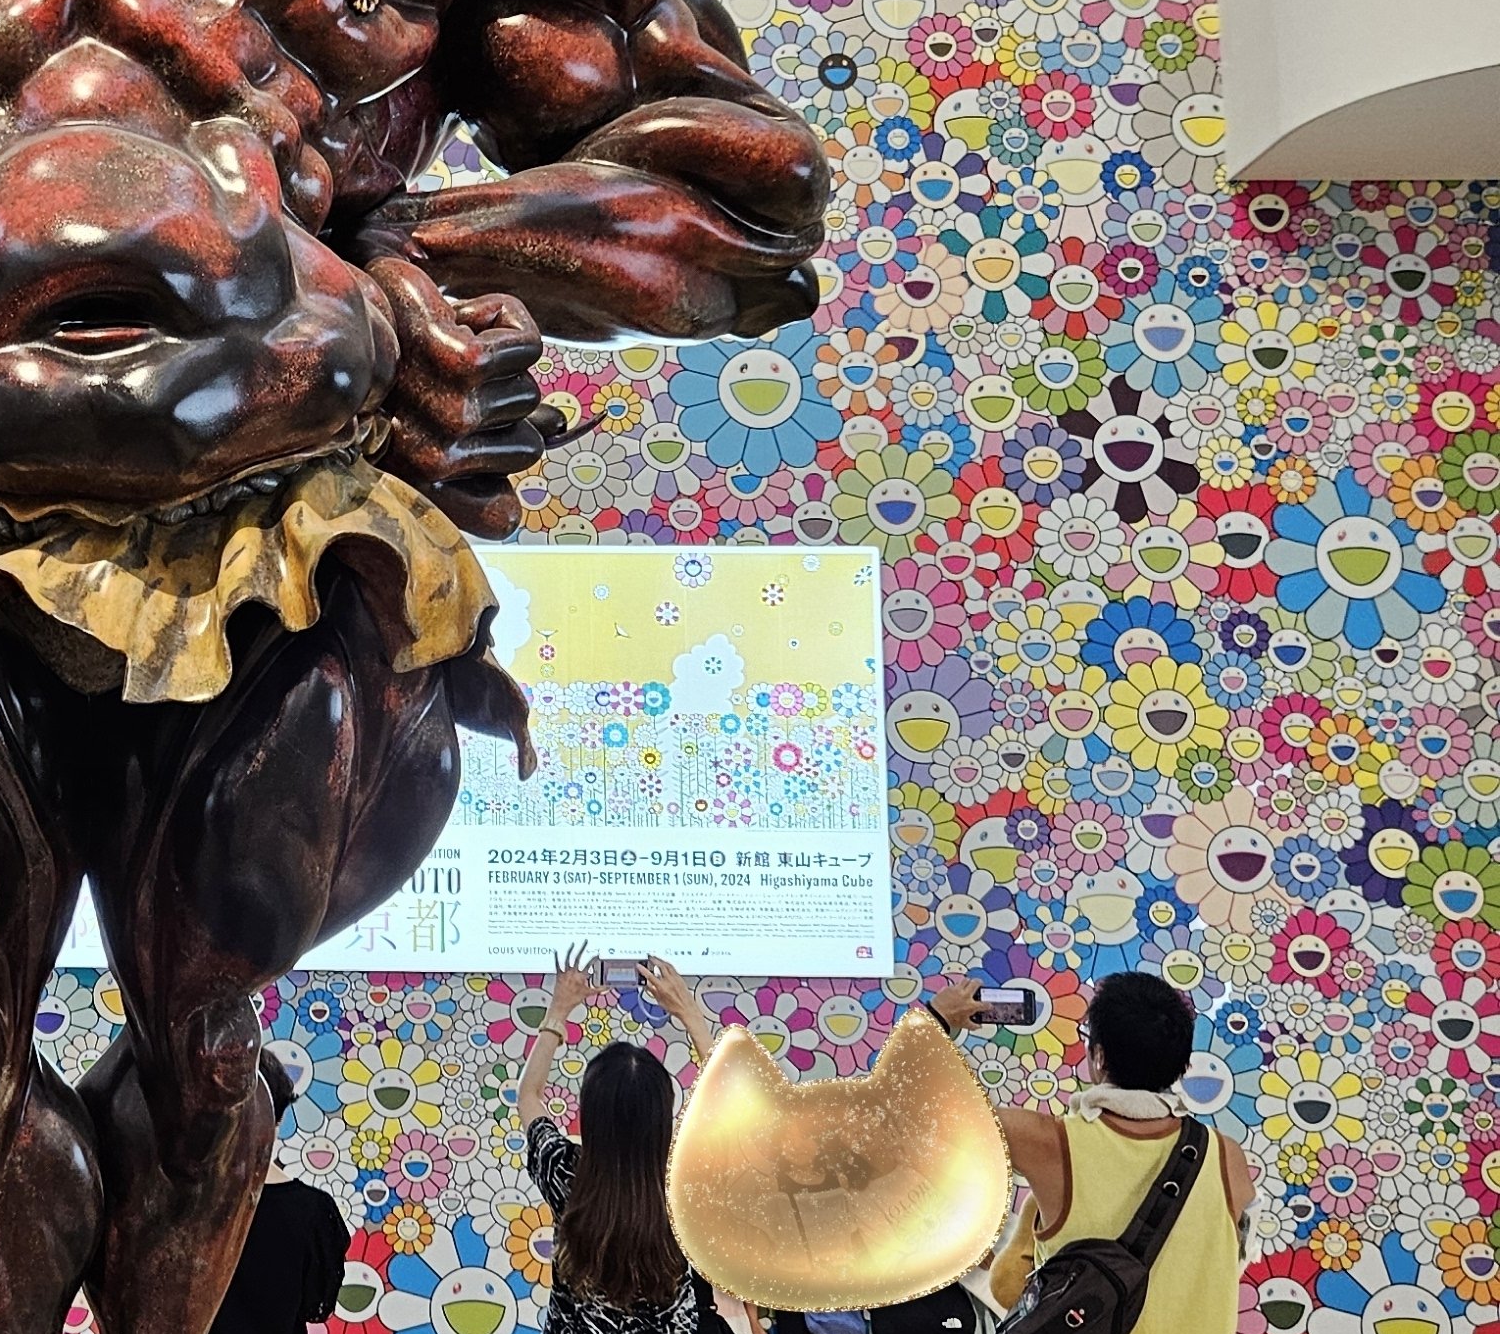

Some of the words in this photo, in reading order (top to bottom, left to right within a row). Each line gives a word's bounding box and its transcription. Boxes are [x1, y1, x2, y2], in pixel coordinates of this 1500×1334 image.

[736, 850, 770, 868] 新館
[777, 851, 875, 868] 東山キューブ
[400, 867, 461, 895] OTO
[488, 870, 550, 885] FEBRUARY
[553, 871, 561, 885] 3
[674, 872, 680, 886] 1
[683, 872, 718, 888] (SUN),
[721, 873, 751, 887] 2024
[760, 873, 838, 890] Higashiyama
[842, 874, 874, 888] Cube
[488, 946, 515, 955] LOUIS
